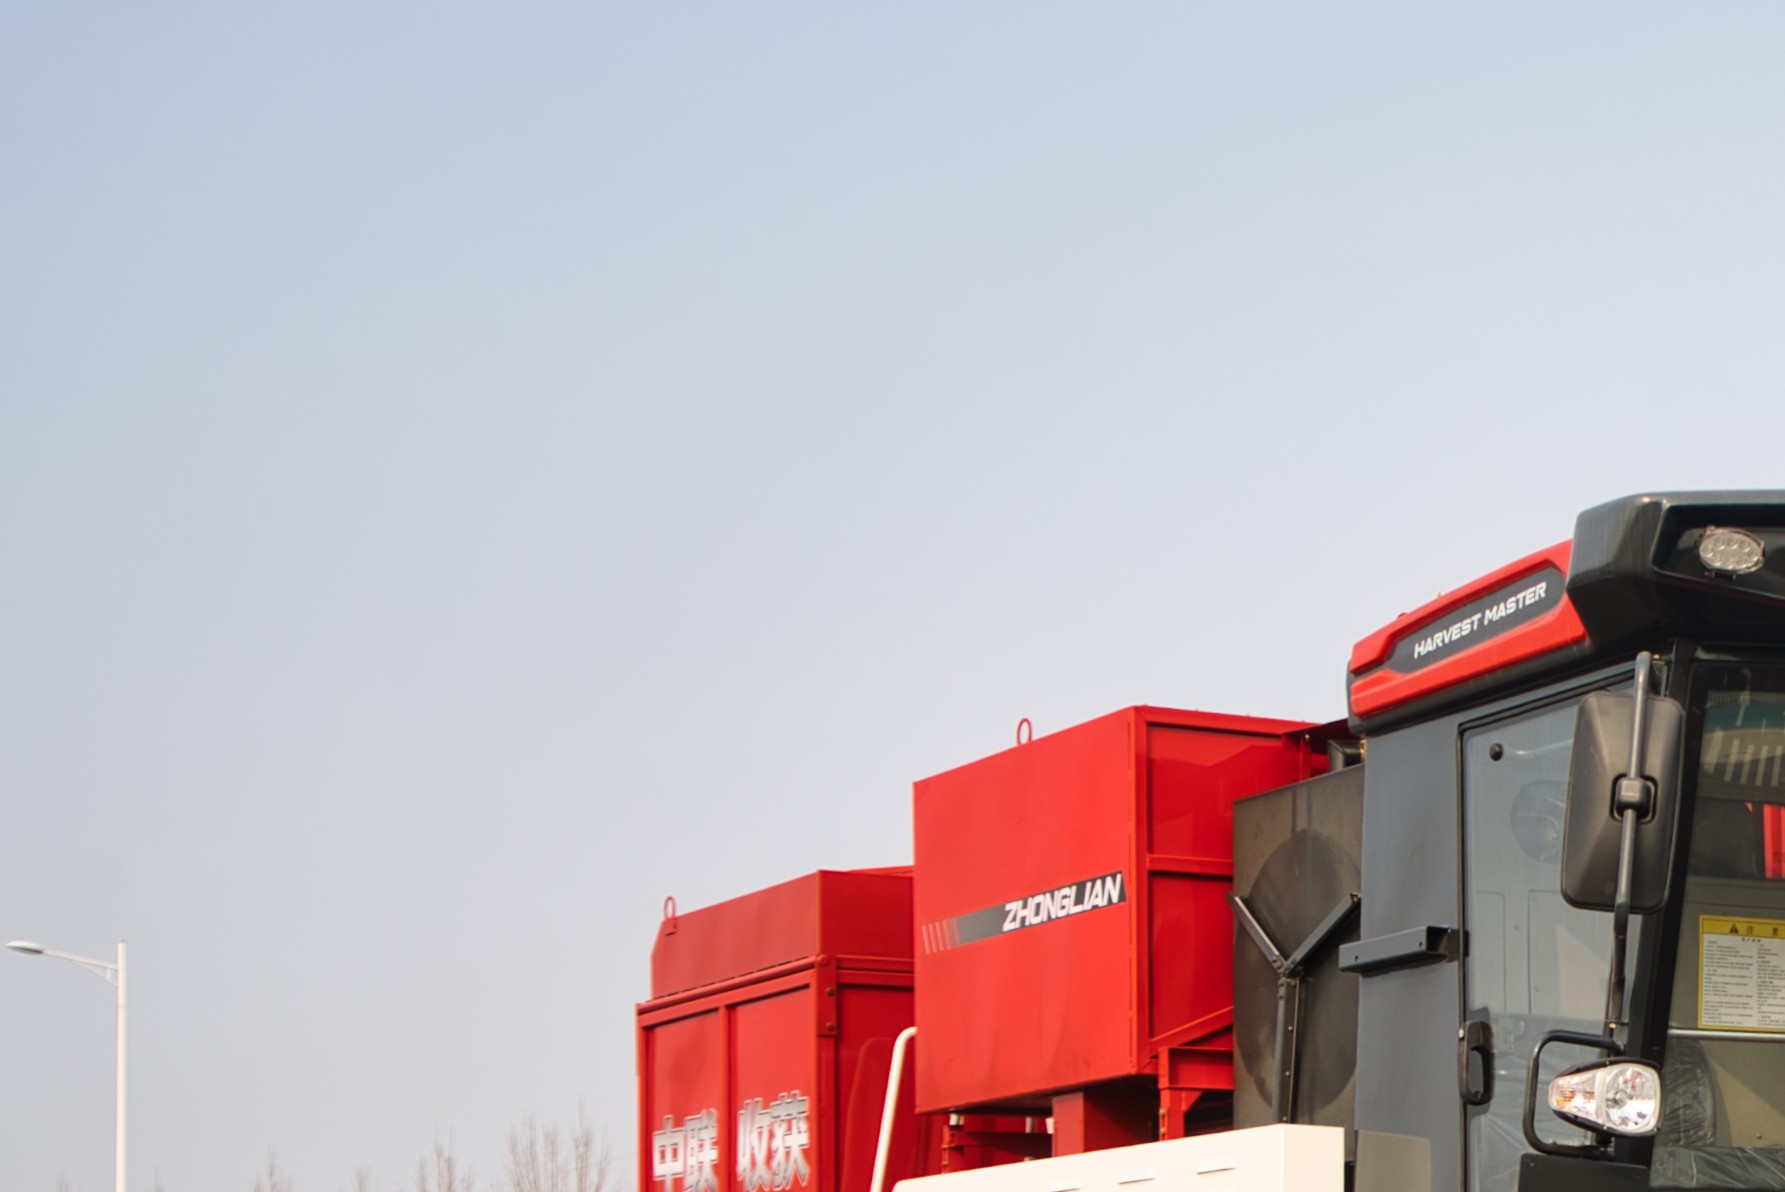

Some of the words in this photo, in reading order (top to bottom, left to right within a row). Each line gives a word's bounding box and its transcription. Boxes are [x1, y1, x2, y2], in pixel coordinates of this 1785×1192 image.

[1413, 614, 1480, 660] HARVEST
[1483, 580, 1548, 627] MASTER
[1002, 871, 1124, 932] ZHONGLIAN
